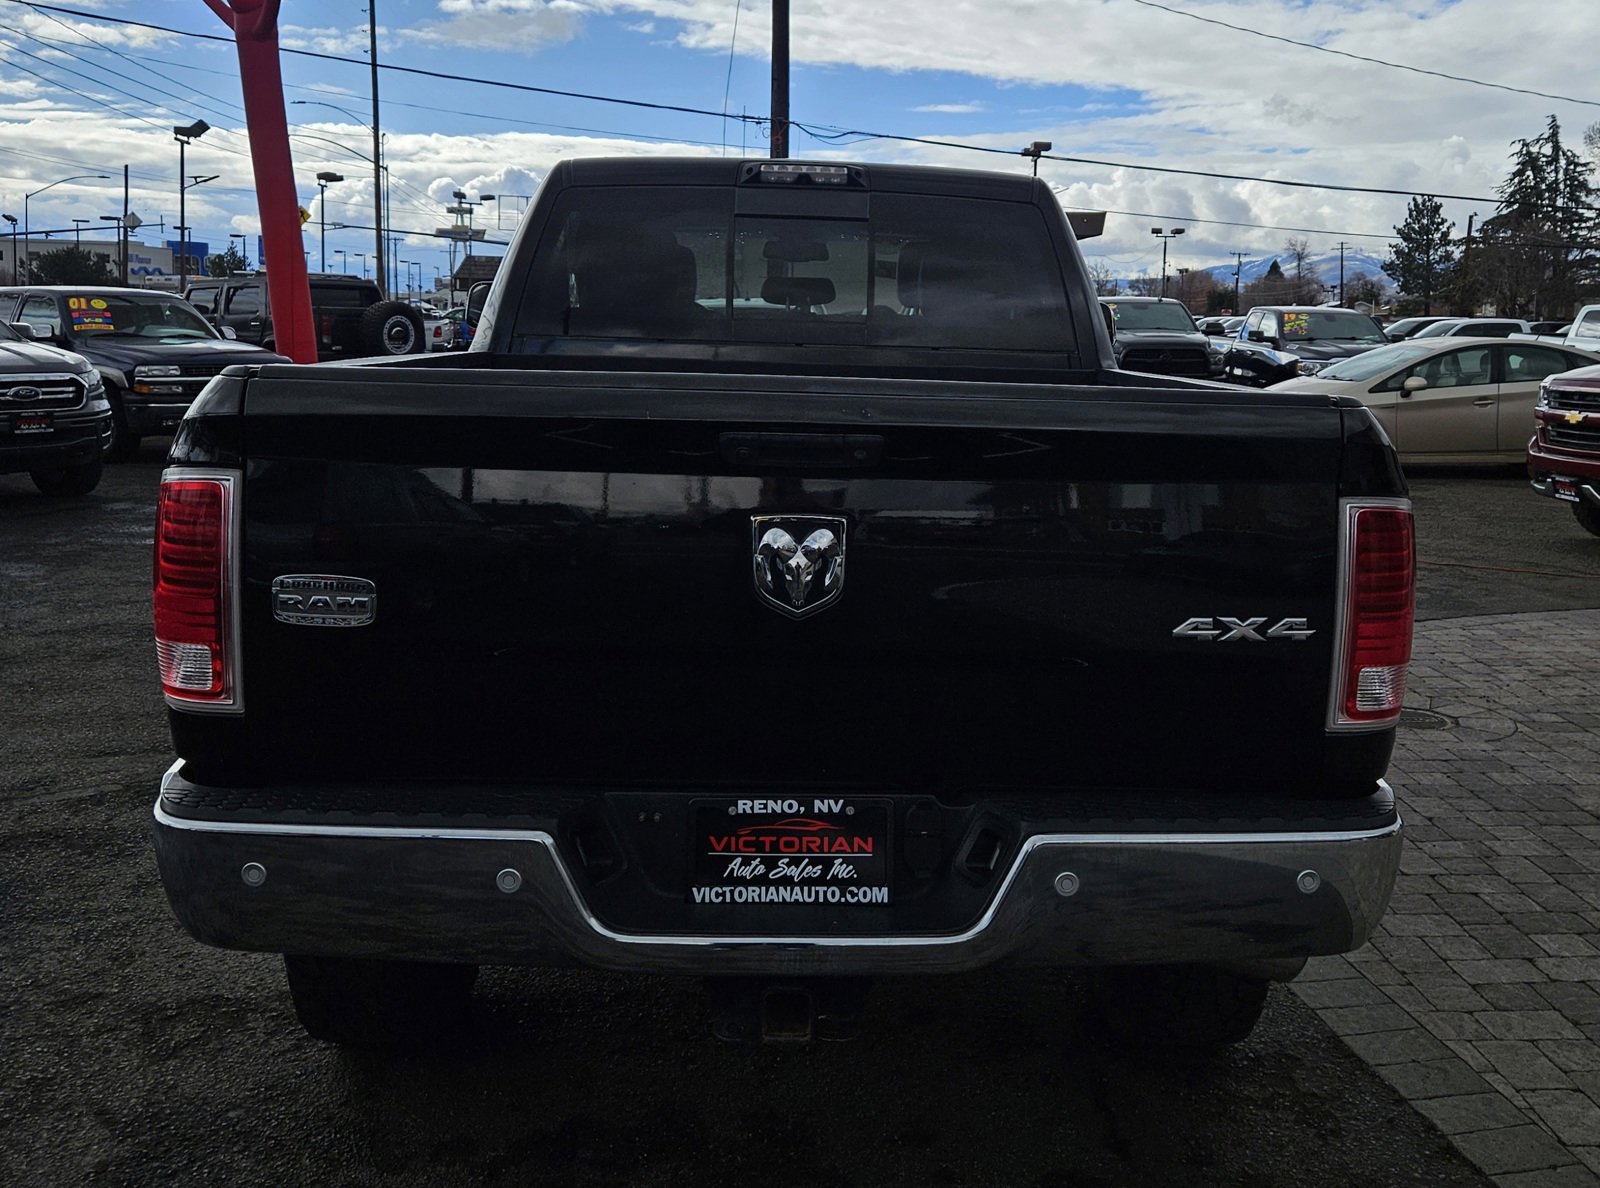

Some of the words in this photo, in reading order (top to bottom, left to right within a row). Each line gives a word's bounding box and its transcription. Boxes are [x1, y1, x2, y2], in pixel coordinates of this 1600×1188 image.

[69, 297, 88, 310] 01
[278, 594, 369, 611] RAM
[1172, 616, 1317, 641] 4X4
[737, 800, 806, 815] RENO,
[814, 800, 844, 814] NV
[708, 836, 873, 853] VICTORIAN
[723, 857, 766, 880] Auto
[769, 858, 822, 882] Sales
[827, 858, 858, 880] Inc.
[692, 886, 888, 903] VICTORIANAUTO.COM
